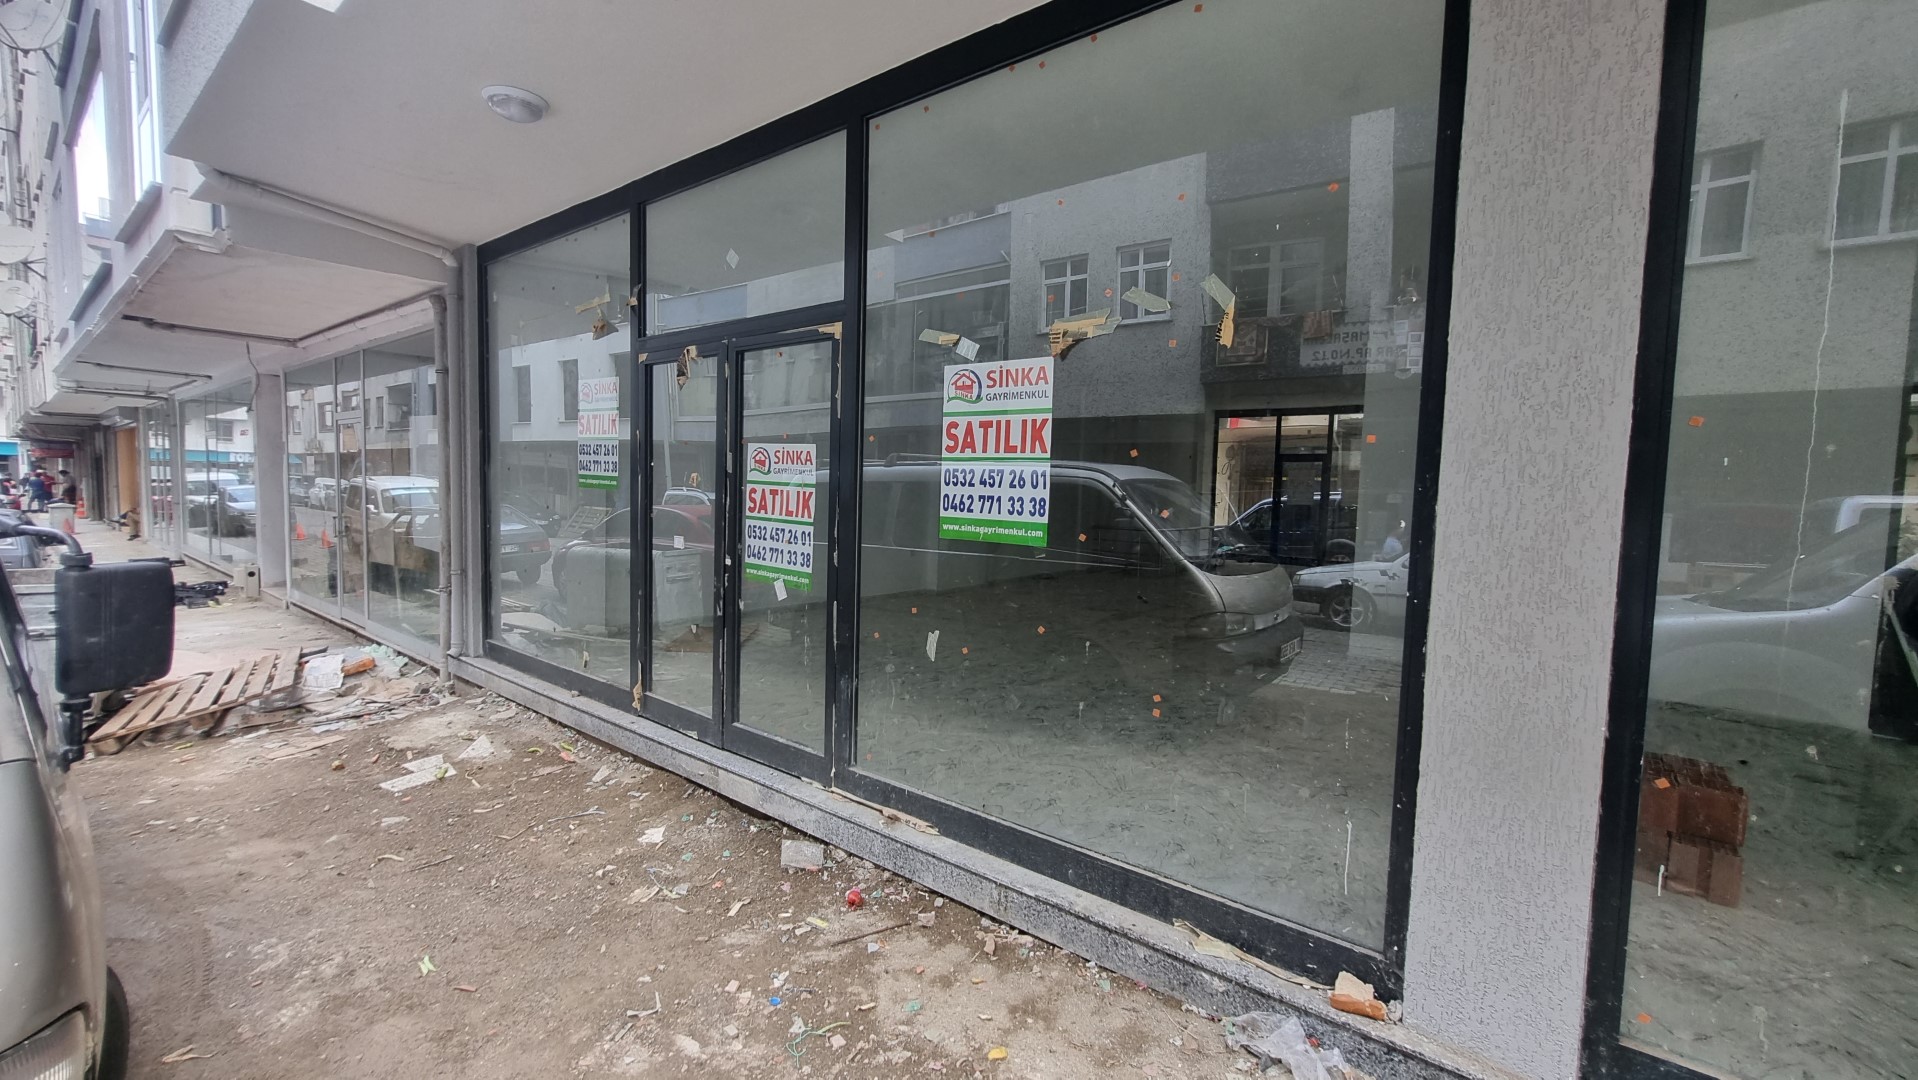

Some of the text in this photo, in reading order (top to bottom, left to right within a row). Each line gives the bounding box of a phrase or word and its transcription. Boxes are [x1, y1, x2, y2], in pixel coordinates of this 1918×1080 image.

[986, 365, 1049, 389] SİNKA
[986, 390, 1049, 402] GAYRİMENKUL
[578, 413, 618, 435] SATILIK
[945, 418, 1049, 454] SATILIK
[579, 443, 617, 457] 0532 457 26 01
[774, 447, 813, 466] SİNKA
[579, 459, 617, 473] 0462 771 33 38
[944, 468, 1047, 490] 0532 457 26 01
[748, 488, 813, 519] SATILIK
[943, 493, 1047, 517] 0462 771 33 38
[747, 524, 811, 547] 0532 457 26 01
[943, 523, 1043, 538] www.sinkagayrimenkul.com
[747, 544, 811, 569] 0462 771 33 38
